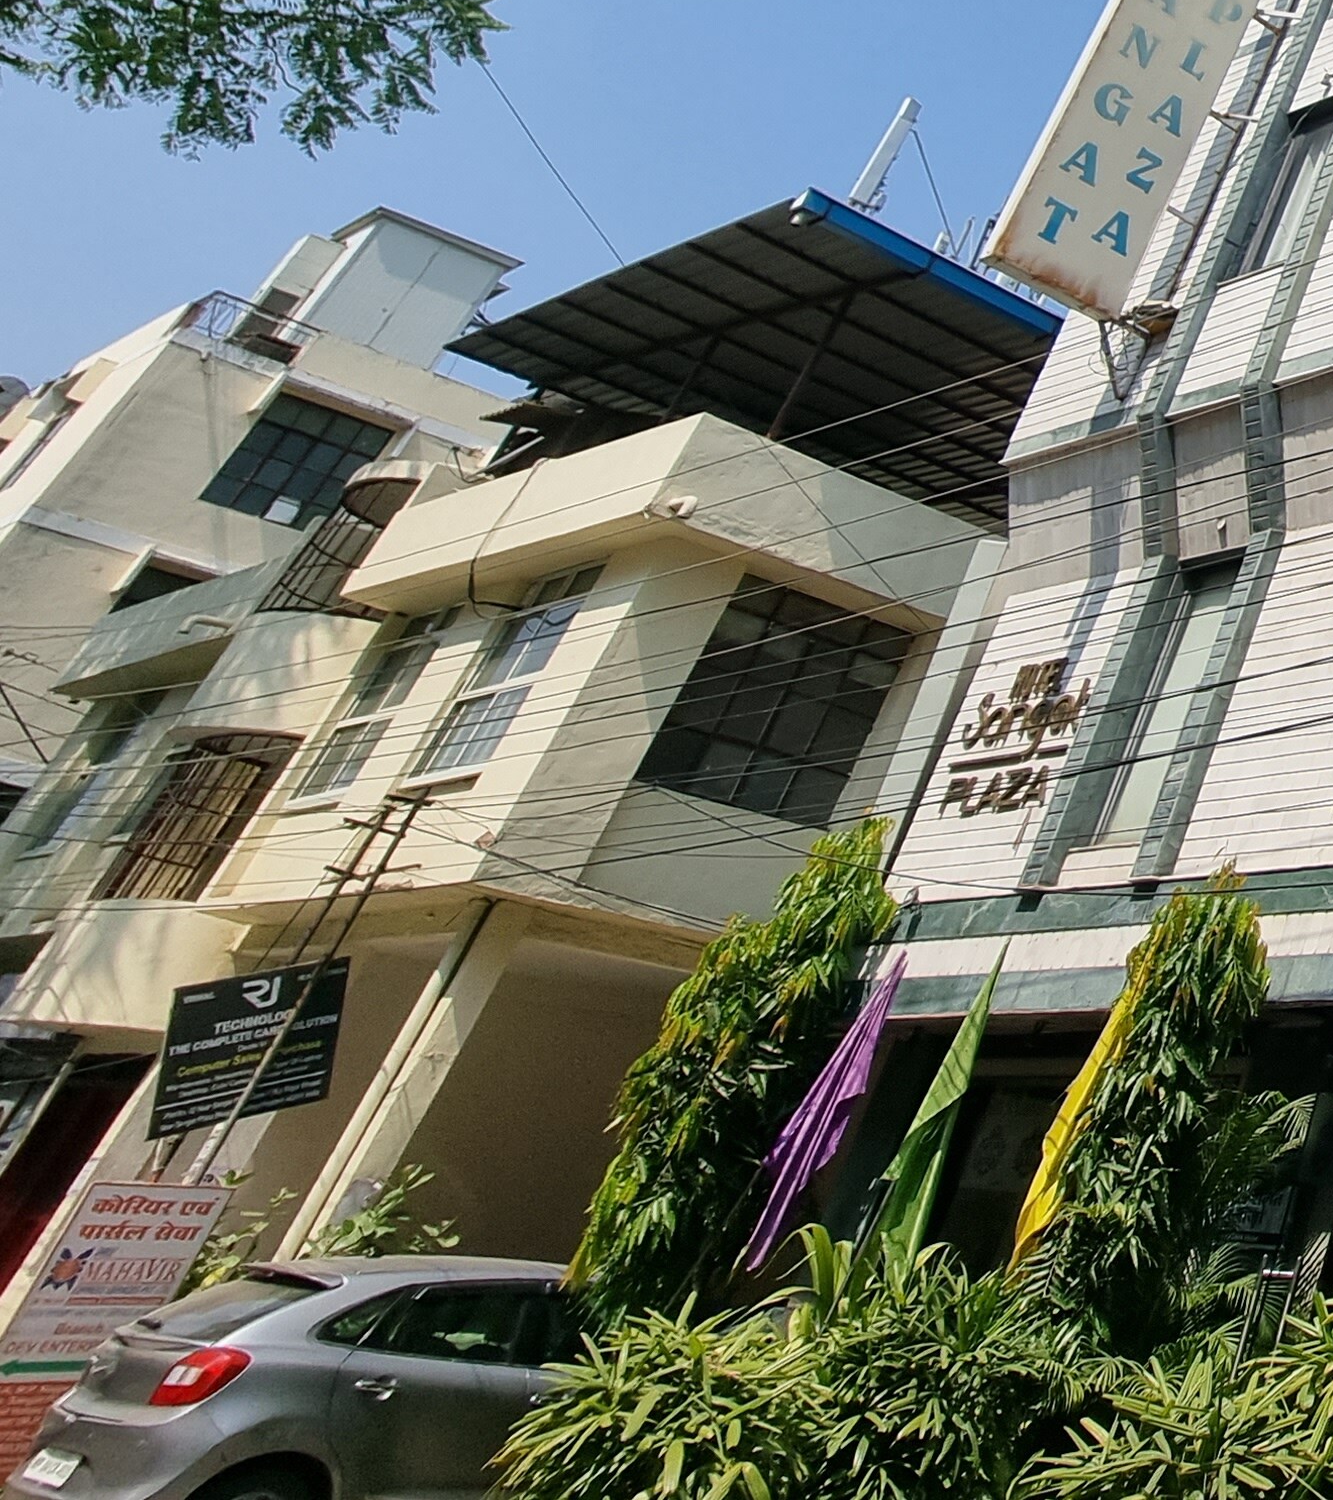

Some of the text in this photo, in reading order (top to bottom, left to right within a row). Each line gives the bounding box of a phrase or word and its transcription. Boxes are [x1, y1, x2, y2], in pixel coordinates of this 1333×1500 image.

[939, 765, 1050, 818] PLAZA
[193, 1030, 254, 1051] COMPLETE
[179, 1196, 220, 1216] एवं
[154, 1220, 204, 1241] सेवा
[82, 1258, 183, 1283] MAHAVIR
